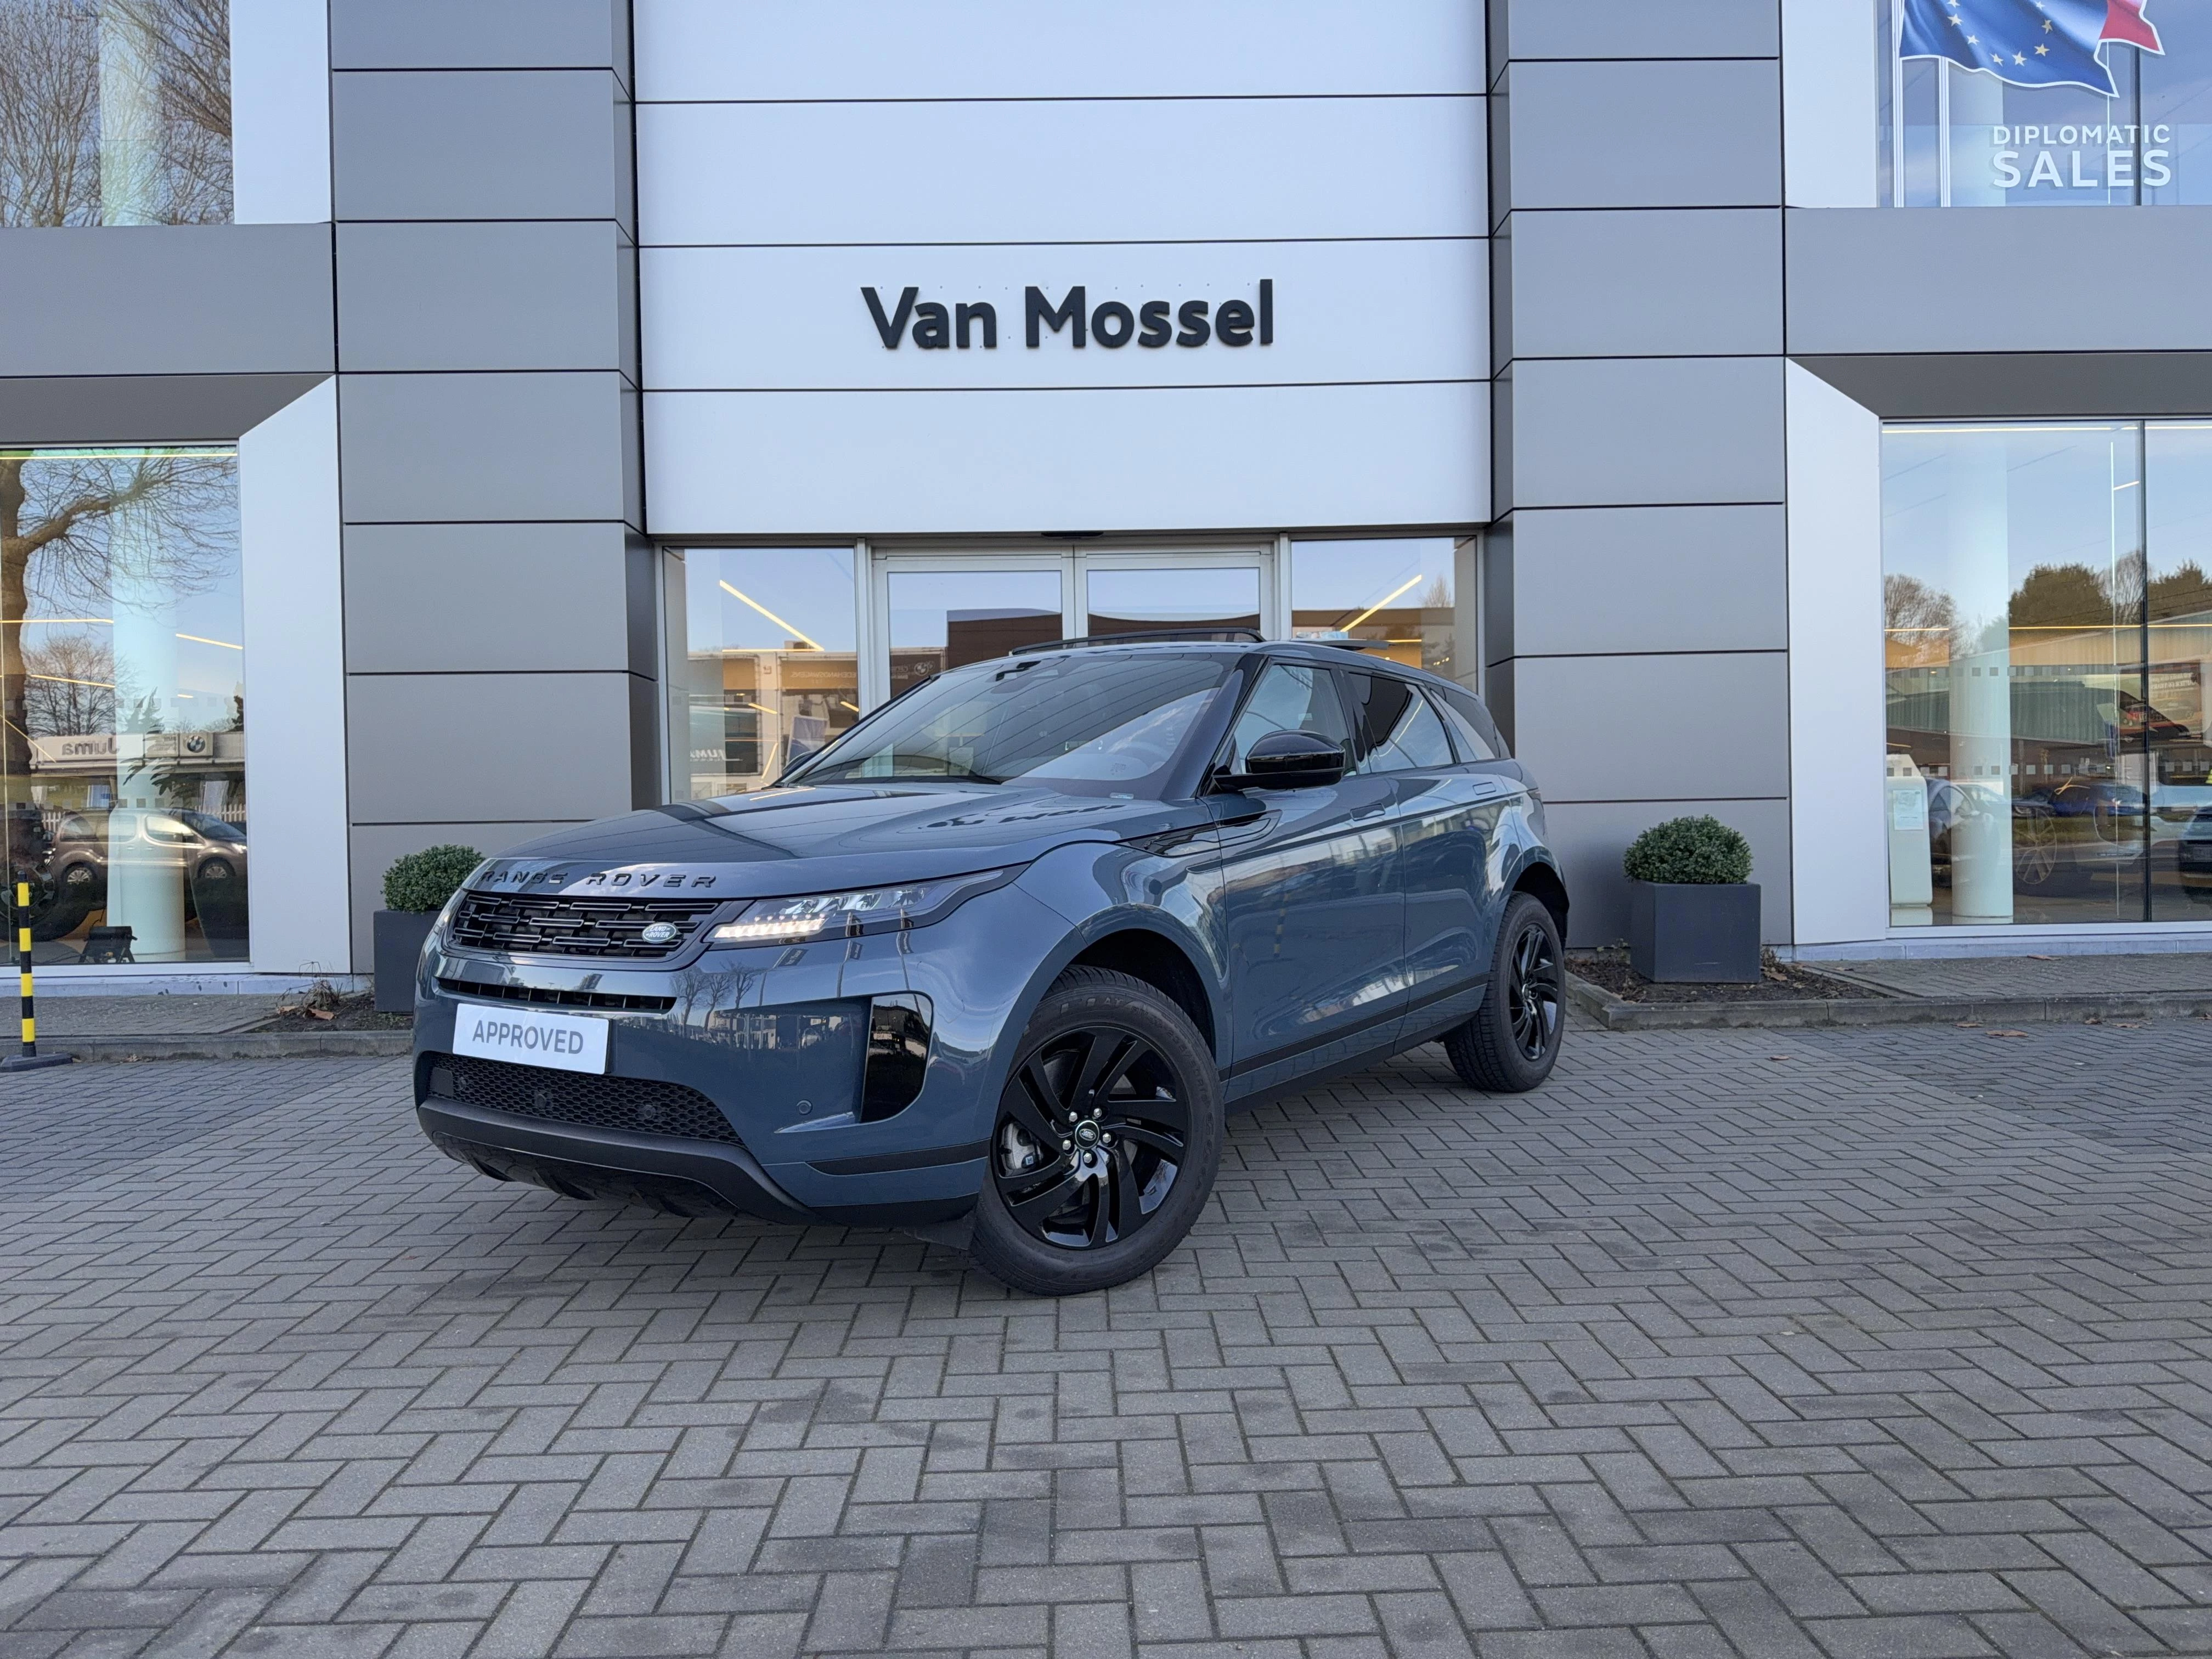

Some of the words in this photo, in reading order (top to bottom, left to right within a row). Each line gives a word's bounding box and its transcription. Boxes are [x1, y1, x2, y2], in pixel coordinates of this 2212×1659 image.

[1993, 125, 2171, 144] DIPLOMATIC
[1993, 150, 2171, 188] SALES
[860, 286, 997, 349] Van
[1025, 279, 1273, 348] Mossel
[479, 870, 568, 884] RANGE
[585, 873, 716, 888] ROVER
[472, 1020, 583, 1054] APPROVED
